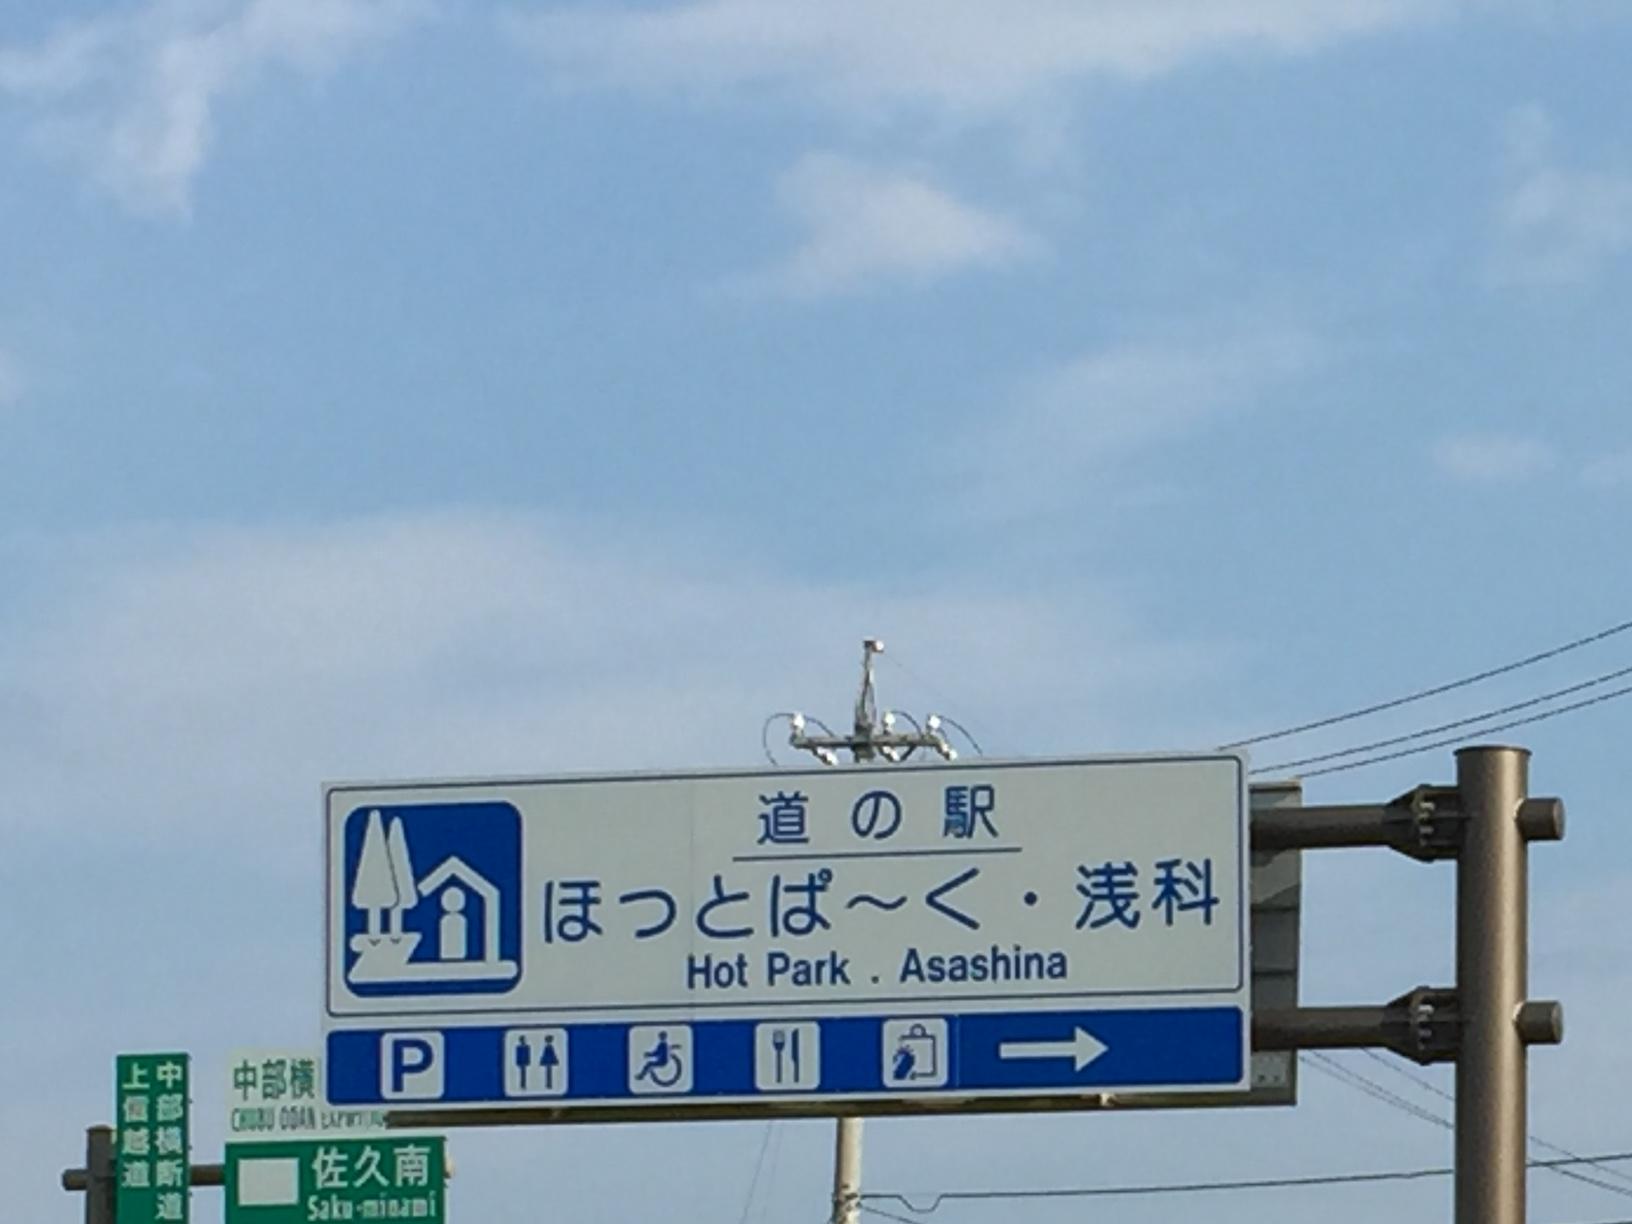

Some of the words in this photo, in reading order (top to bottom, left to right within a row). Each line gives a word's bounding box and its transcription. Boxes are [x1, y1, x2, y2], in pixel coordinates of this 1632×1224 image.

[756, 785, 999, 845] 道の駅
[686, 954, 748, 990] Hot
[767, 951, 850, 987] Park
[900, 945, 1068, 983] Asashina
[311, 1143, 432, 1190] 佐久南
